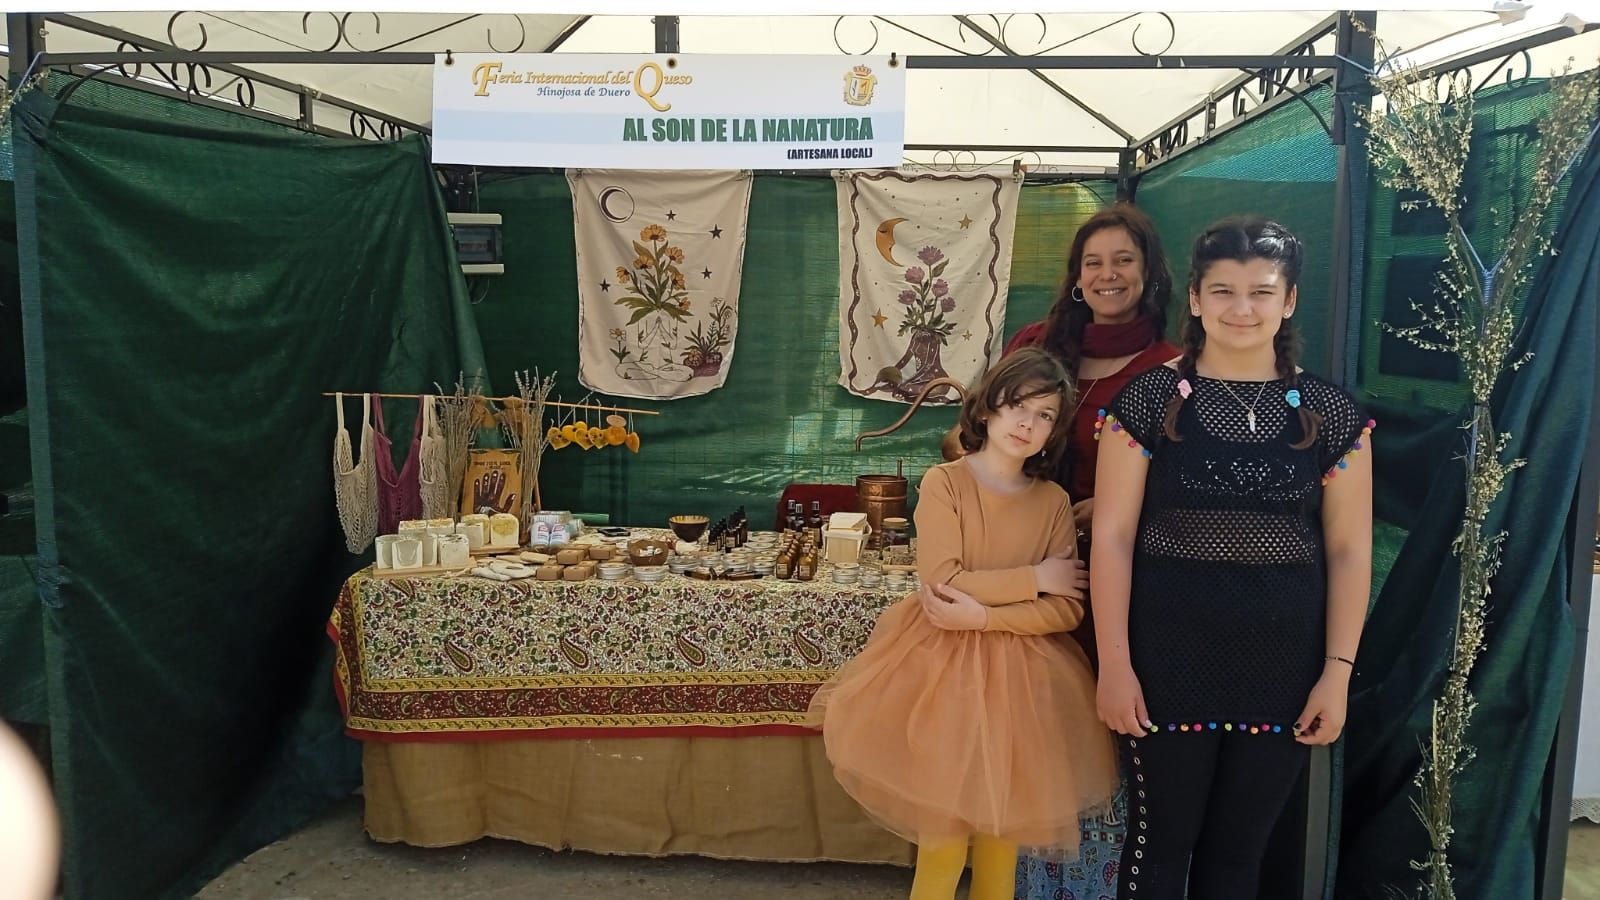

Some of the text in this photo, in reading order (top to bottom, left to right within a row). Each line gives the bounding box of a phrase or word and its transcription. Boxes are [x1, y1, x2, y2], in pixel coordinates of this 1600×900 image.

[472, 62, 693, 112] Feria Internacional del Queso
[537, 86, 631, 99] Hinojosa de Duero
[623, 117, 873, 142] AL SON DE LA NANATURA
[787, 147, 873, 160] (ARTESANA LOCAL)
